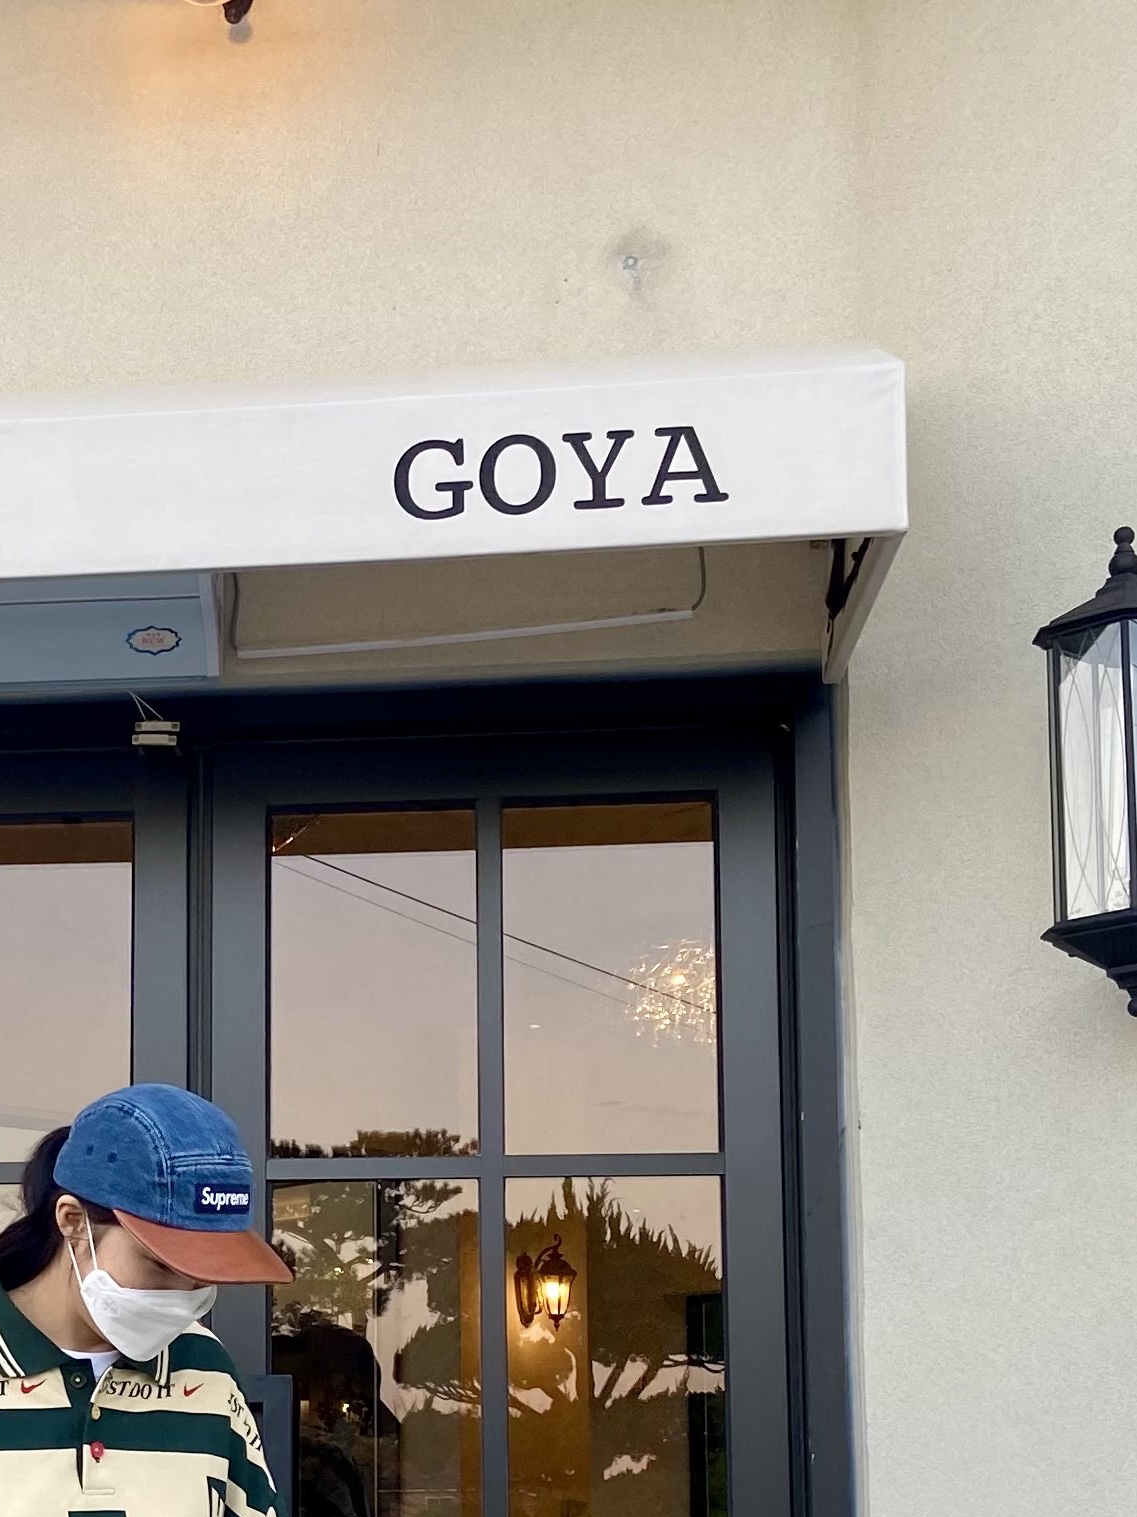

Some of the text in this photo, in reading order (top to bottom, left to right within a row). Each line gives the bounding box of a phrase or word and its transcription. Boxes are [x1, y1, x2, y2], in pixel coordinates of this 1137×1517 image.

[394, 426, 729, 520] GOYA
[201, 1186, 249, 1211] Supreme
[129, 1383, 152, 1399] DO
